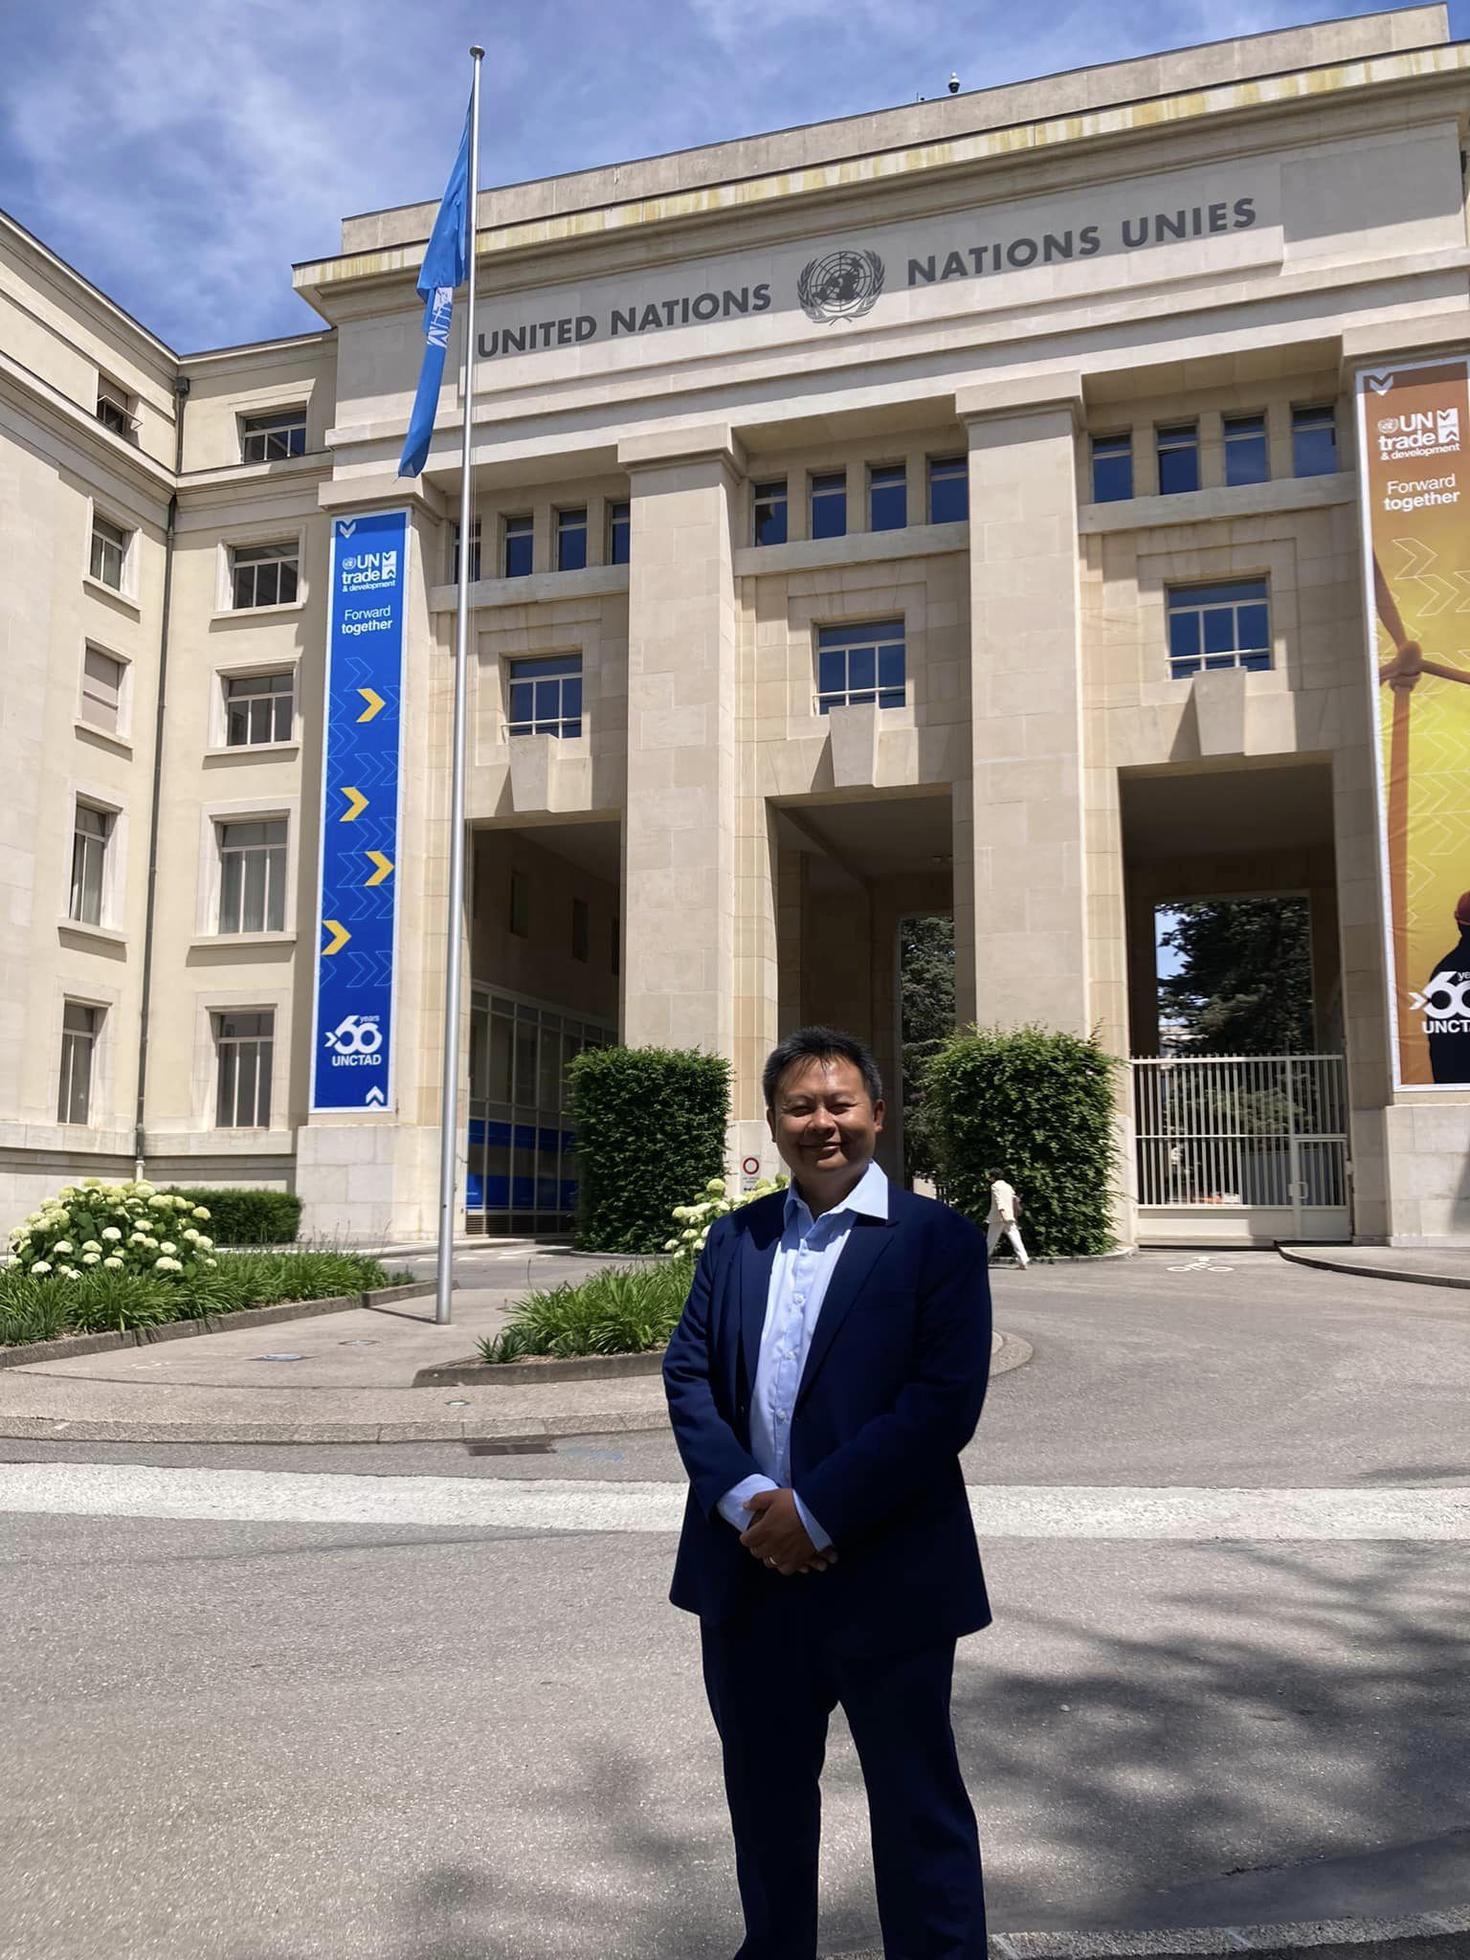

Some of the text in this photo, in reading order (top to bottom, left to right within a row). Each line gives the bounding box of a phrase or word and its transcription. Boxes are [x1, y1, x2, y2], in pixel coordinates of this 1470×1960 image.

[907, 197, 1256, 286] NATIONS UNIES
[478, 284, 772, 358] UNITED NATIONS
[1400, 411, 1433, 430] UN
[1378, 430, 1436, 451] trade
[1380, 443, 1461, 461] & development
[1387, 473, 1457, 495] Forward
[1383, 490, 1461, 512] together
[357, 553, 380, 568] UN
[342, 568, 380, 584] trade
[342, 580, 396, 593] & development
[344, 604, 391, 620] Forward
[341, 619, 393, 635] together
[333, 1014, 383, 1054] 60
[1422, 1019, 1470, 1034] UNCT
[331, 1054, 382, 1067] UNCTAD
